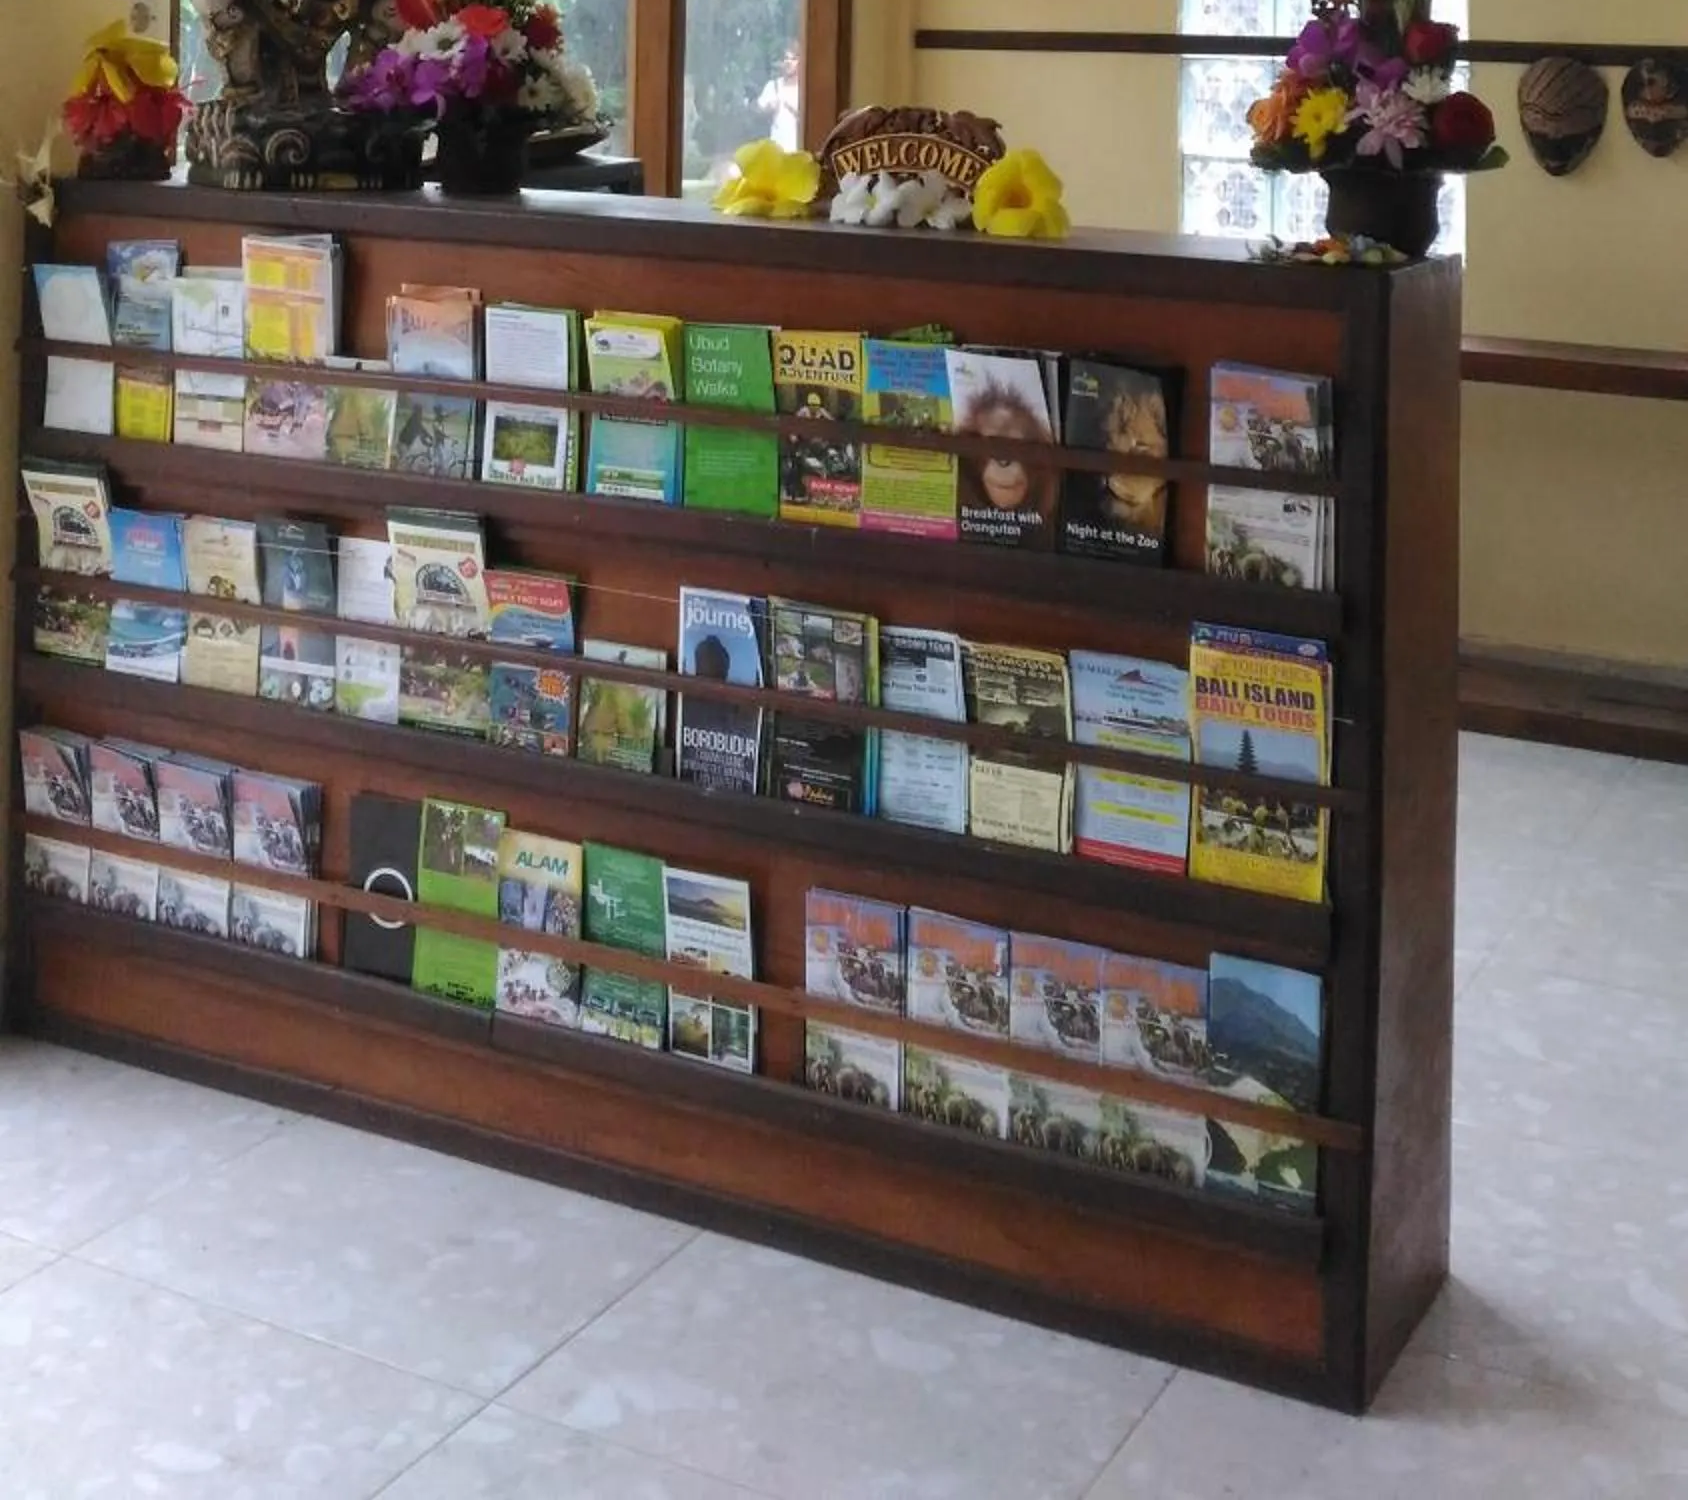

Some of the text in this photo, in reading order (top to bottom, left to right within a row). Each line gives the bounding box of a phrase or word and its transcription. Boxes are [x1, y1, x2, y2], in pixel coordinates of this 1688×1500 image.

[836, 140, 980, 185] WELCOME
[689, 332, 730, 351] Ubud
[691, 355, 743, 379] Botany
[778, 344, 855, 371] QUAD
[692, 378, 739, 397] Walks
[779, 366, 858, 385] ADVENTURE
[961, 504, 1043, 525] Breakfast with
[961, 520, 1021, 537] Orangutan
[1066, 522, 1159, 549] Night at the Zoo
[685, 599, 755, 639] journey
[1196, 675, 1238, 699] BALI
[1244, 682, 1315, 710] ISLAND
[1196, 695, 1316, 727] DAILY TOURS
[683, 726, 755, 758] BOROBUDUR
[515, 852, 569, 876] ALAM
